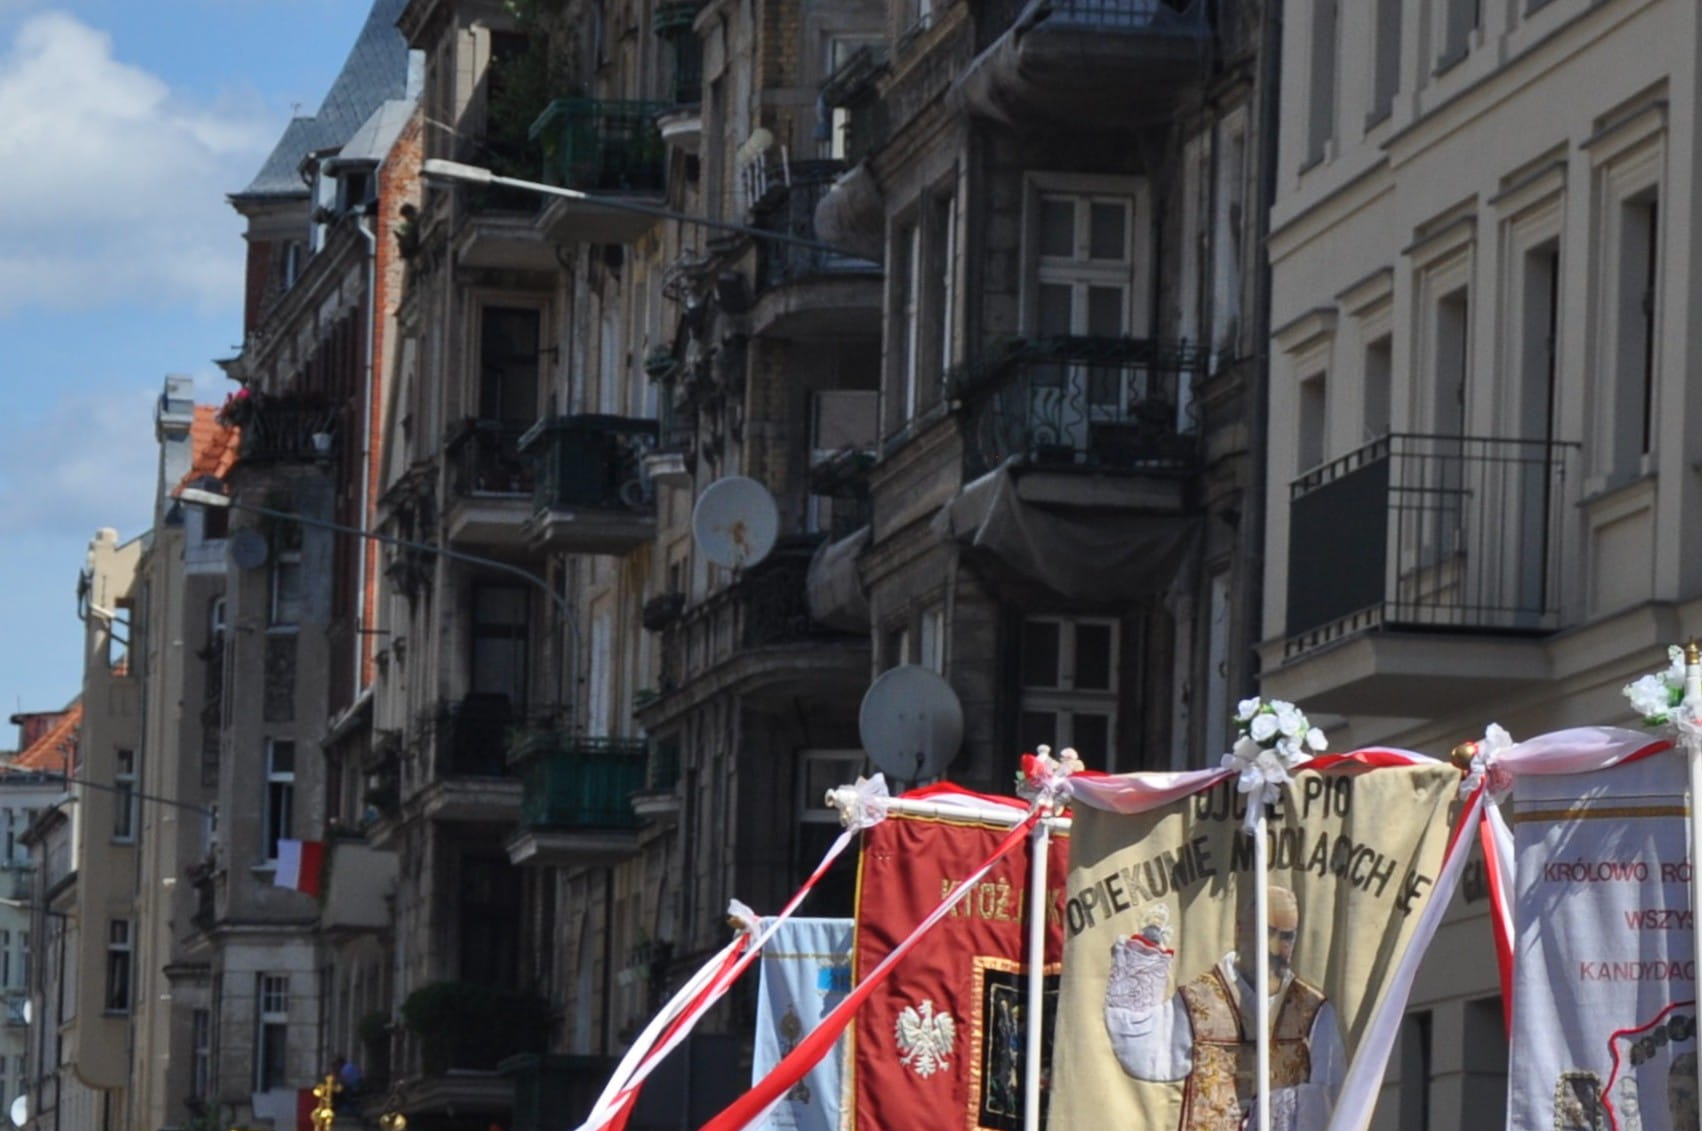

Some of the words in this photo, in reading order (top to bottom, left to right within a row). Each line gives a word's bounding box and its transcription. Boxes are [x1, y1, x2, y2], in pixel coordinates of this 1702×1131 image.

[1303, 775, 1351, 819] PIO
[1067, 836, 1217, 937] OPIEKUNIE
[1544, 856, 1649, 882] KRÓLOWO
[1579, 960, 1695, 982] KANDYDAC
